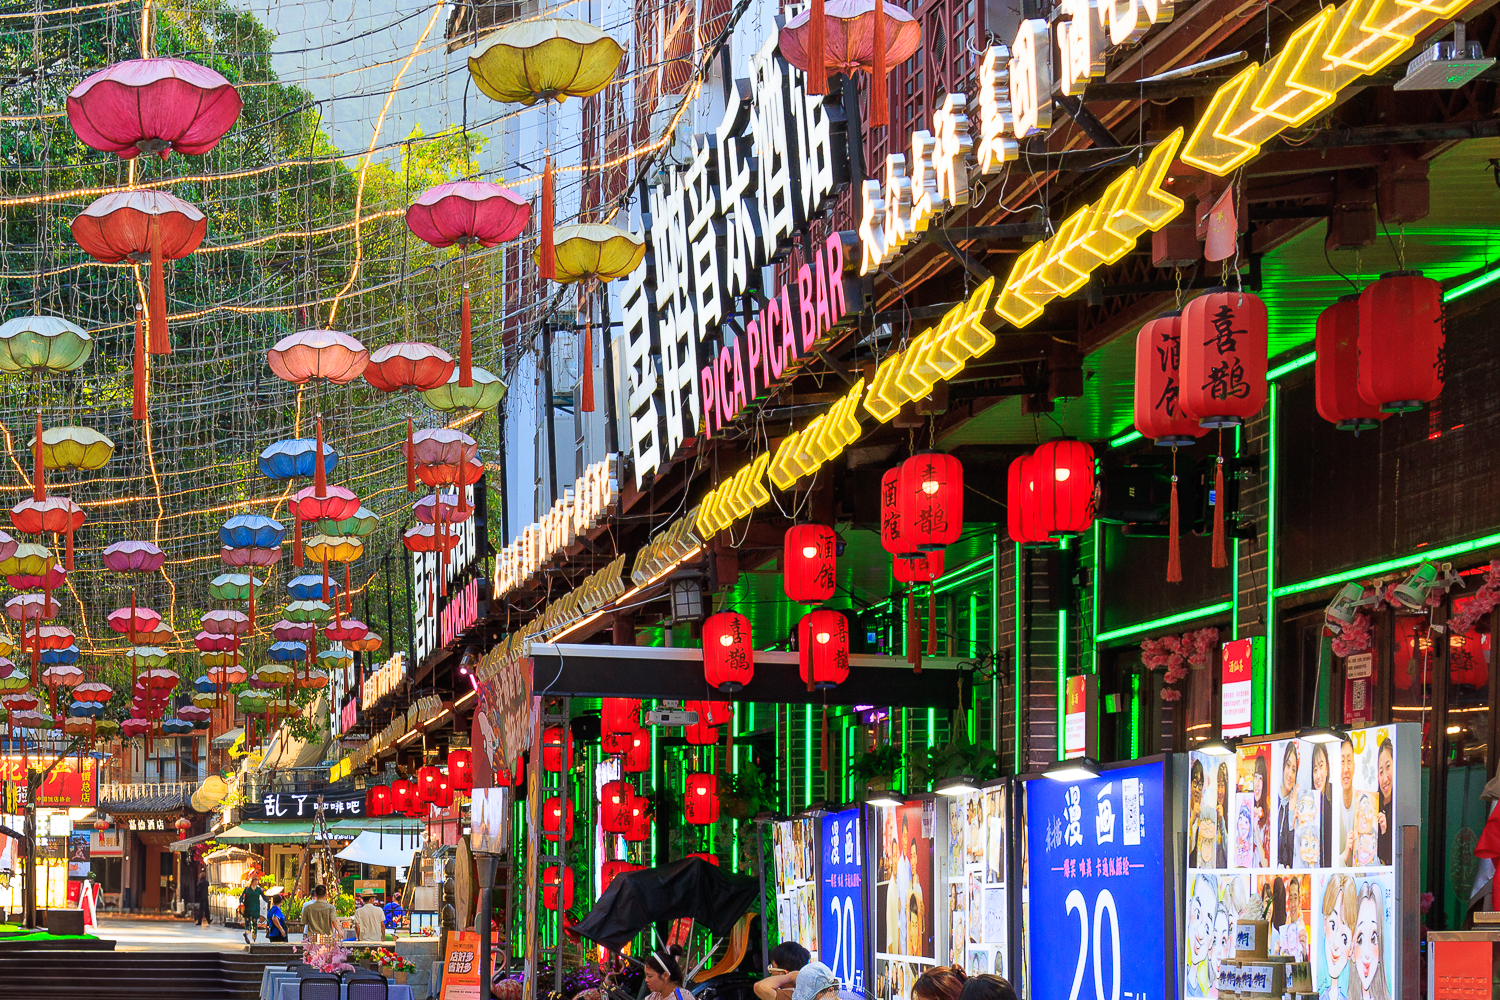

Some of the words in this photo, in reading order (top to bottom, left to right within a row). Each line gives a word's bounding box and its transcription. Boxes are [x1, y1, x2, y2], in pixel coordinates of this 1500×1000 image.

[701, 335, 747, 440] PICA
[746, 283, 798, 401] PICA
[798, 231, 847, 352] BAR
[1202, 304, 1250, 400] 喜鹊
[915, 464, 948, 535] 喜鹊
[815, 534, 836, 591] 酒馆
[724, 616, 750, 671] 喜鹊
[1063, 781, 1116, 847] 漫画
[830, 896, 856, 993] 20
